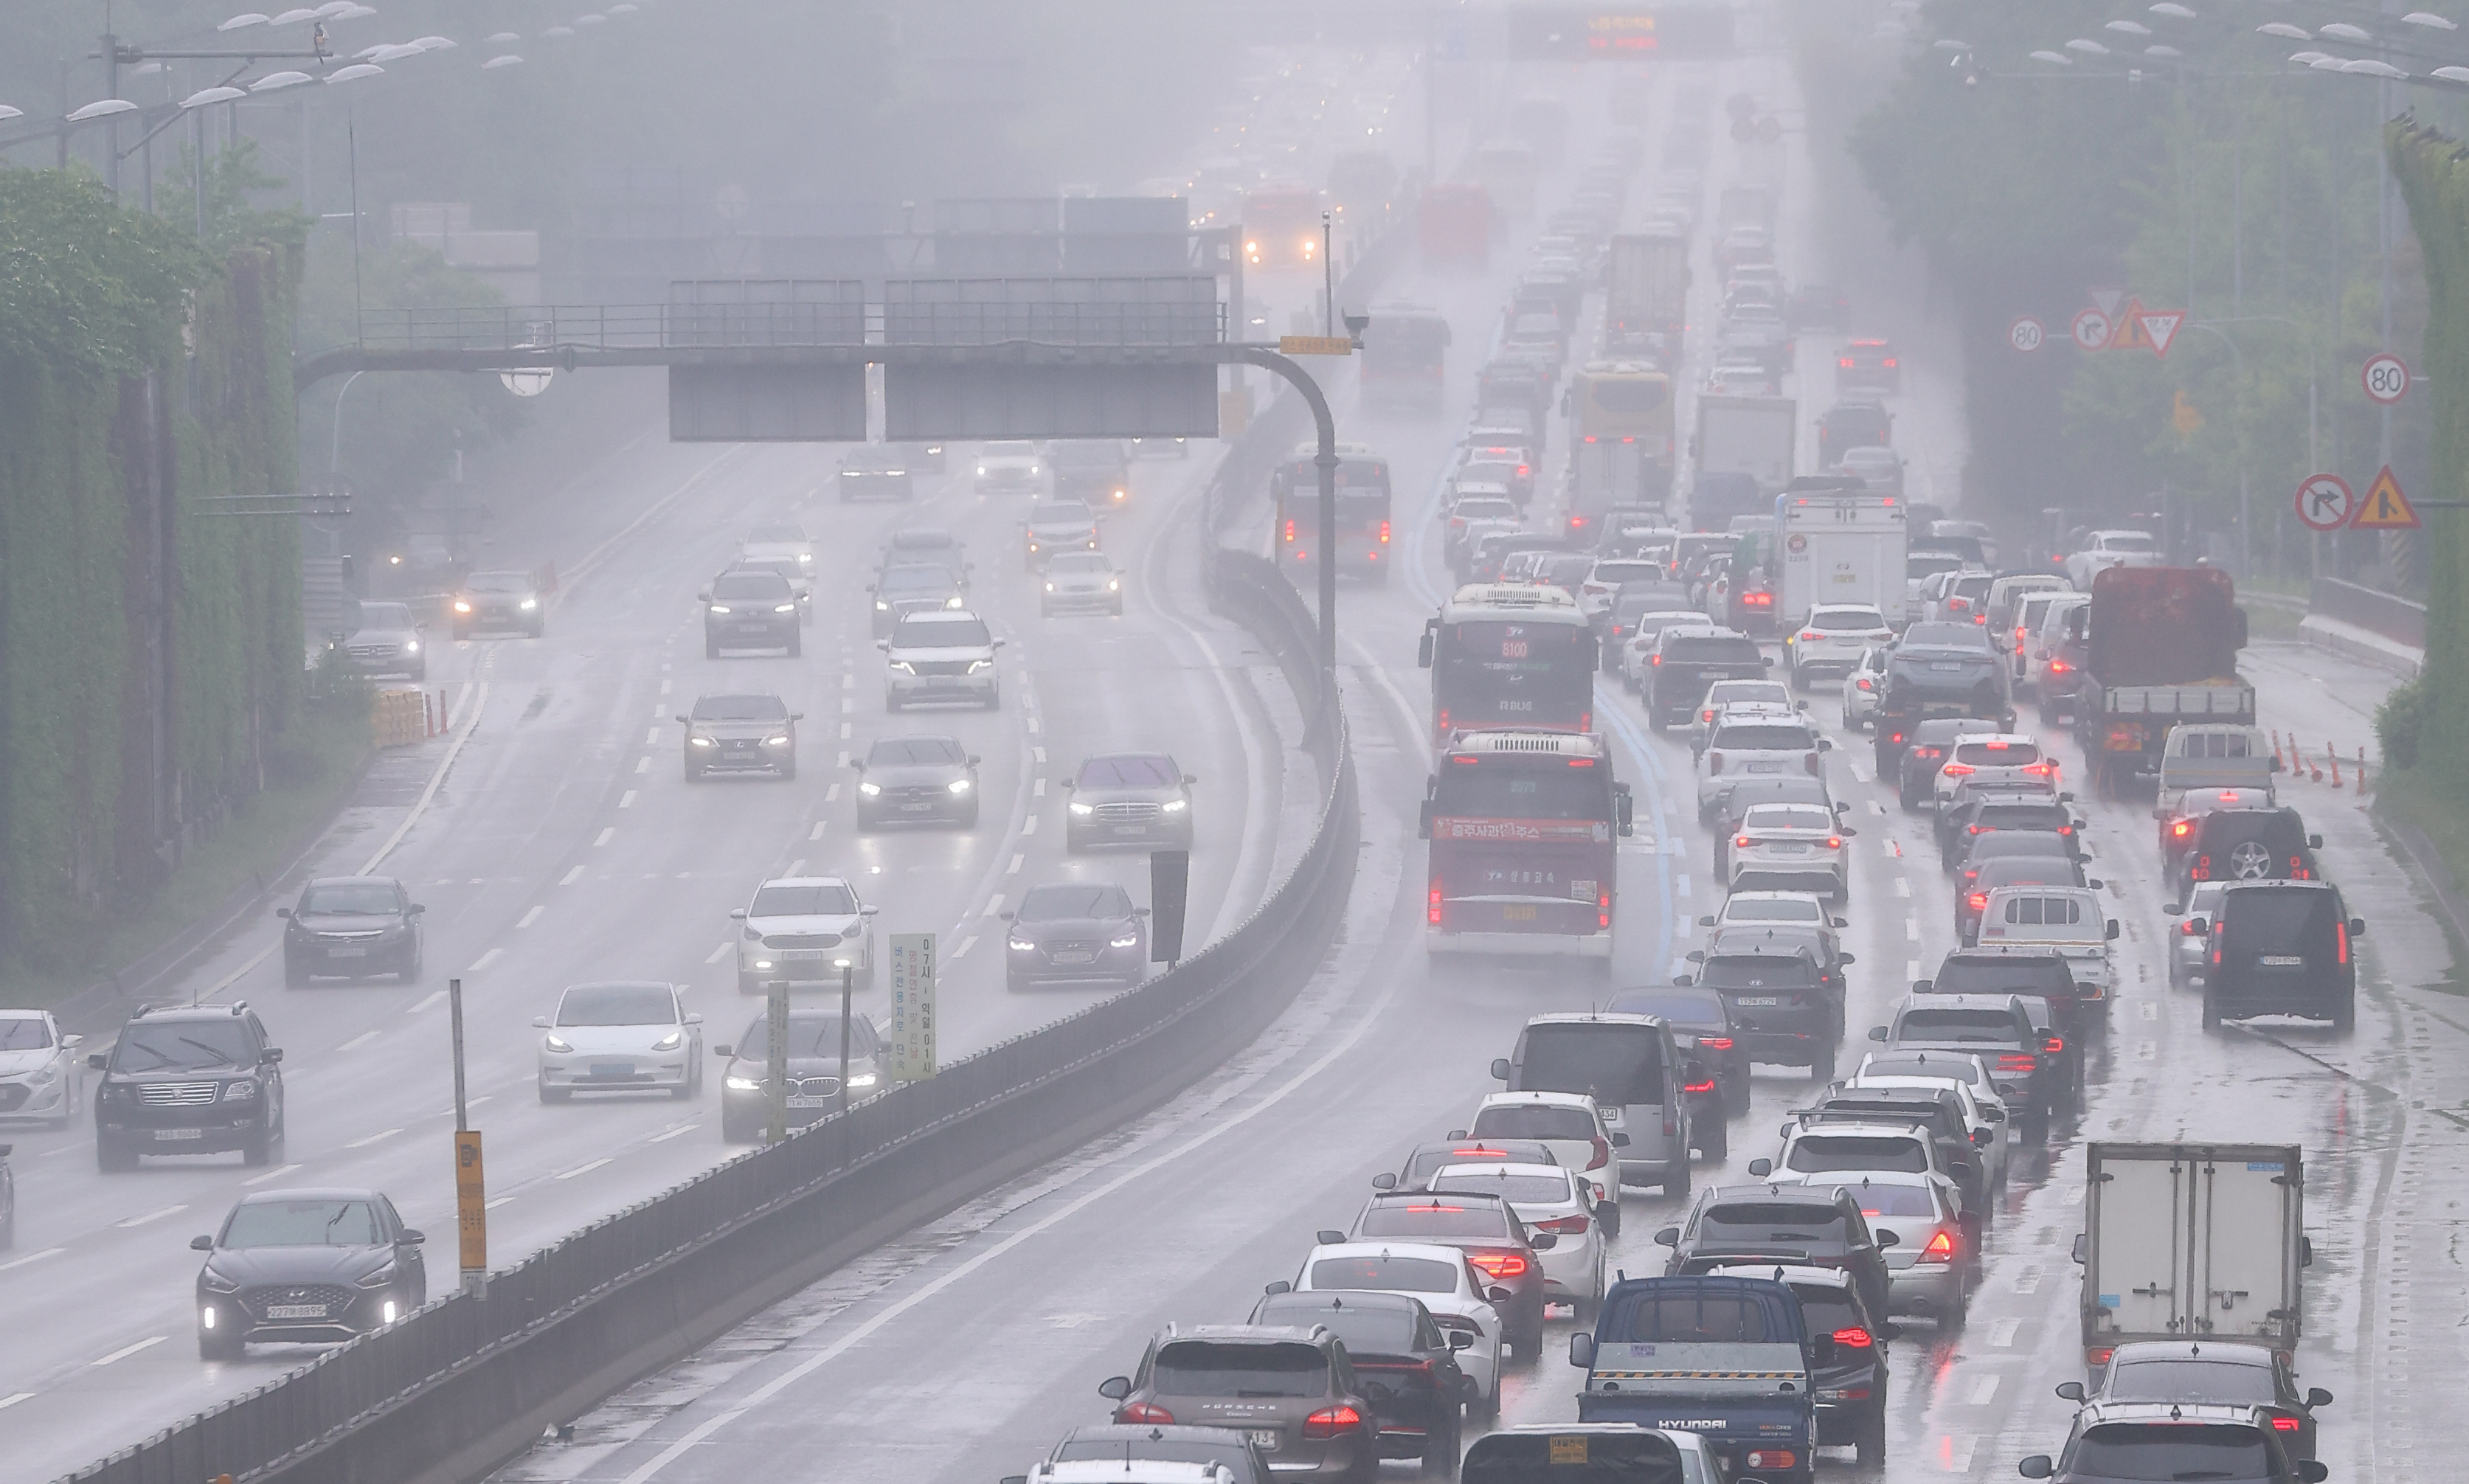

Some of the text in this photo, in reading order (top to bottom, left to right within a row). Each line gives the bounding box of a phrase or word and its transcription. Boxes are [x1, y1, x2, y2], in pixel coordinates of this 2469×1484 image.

[2016, 326, 2037, 344] 80
[2372, 367, 2401, 392] 80
[1503, 642, 1527, 657] 8100
[896, 1044, 904, 1070] 단속
[1658, 1420, 1727, 1429] HYUNDAI
